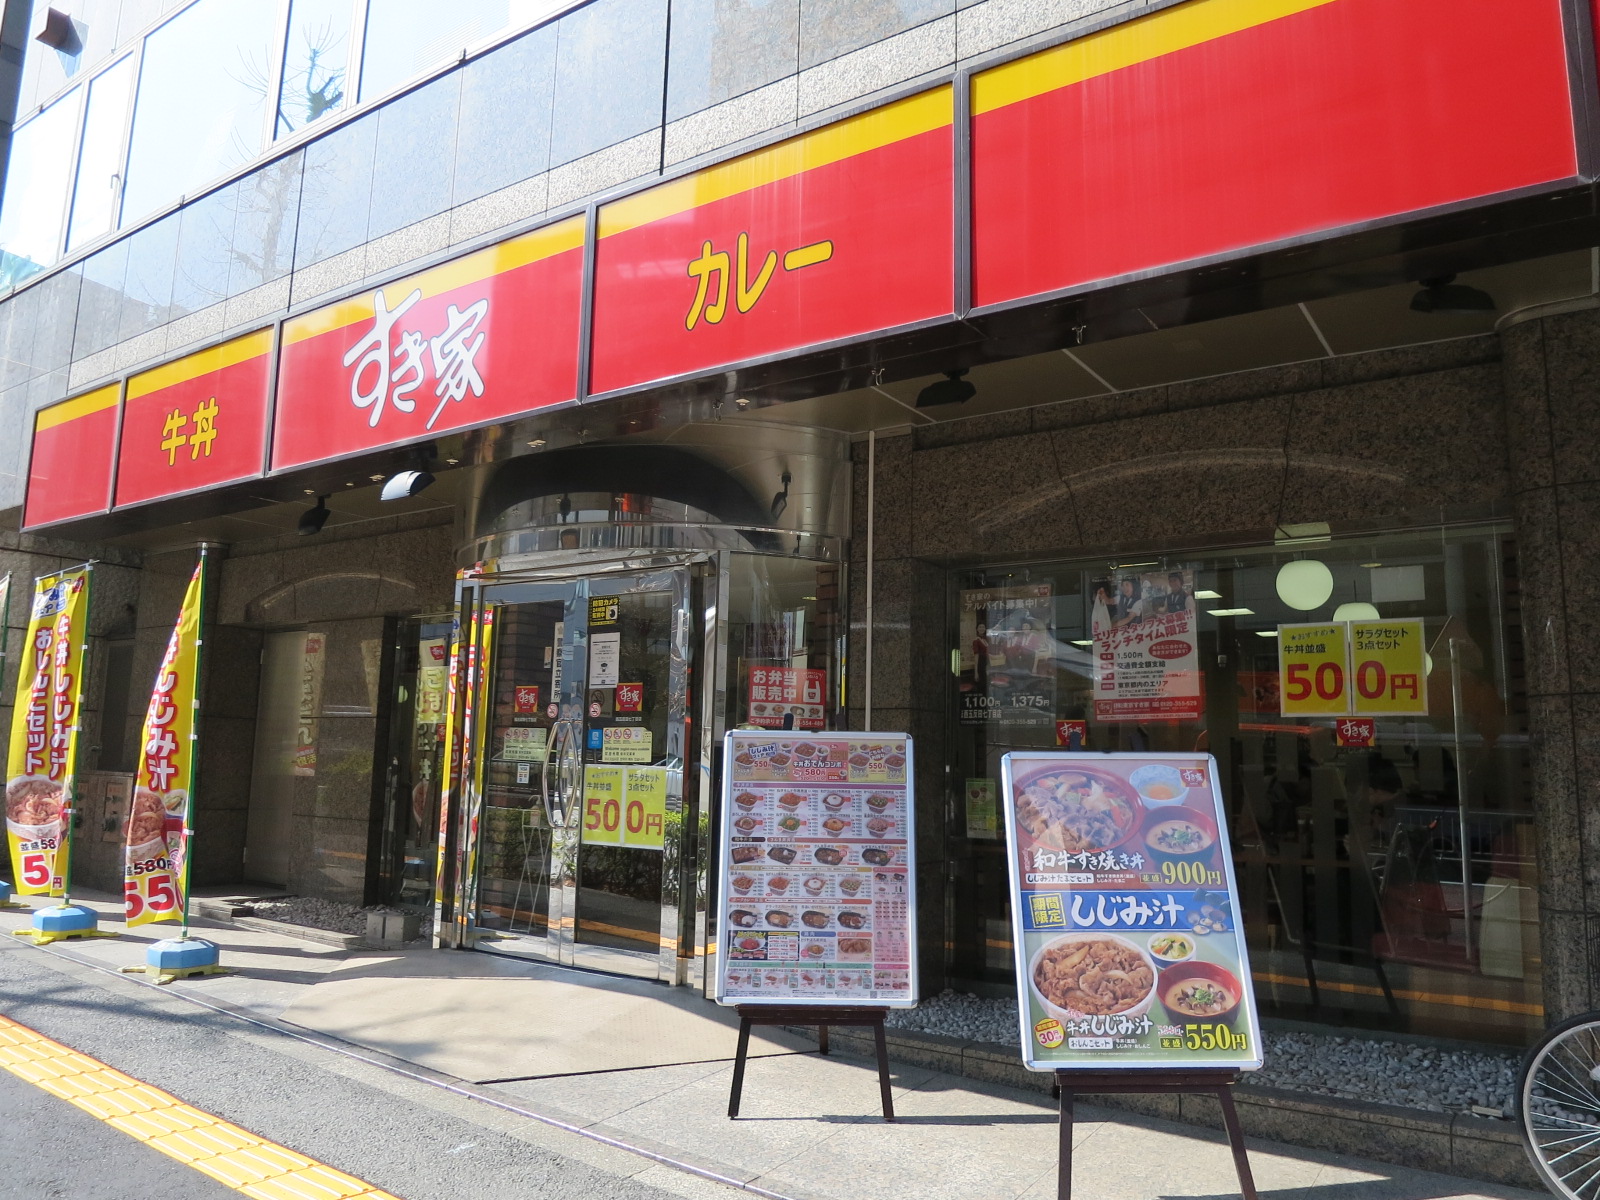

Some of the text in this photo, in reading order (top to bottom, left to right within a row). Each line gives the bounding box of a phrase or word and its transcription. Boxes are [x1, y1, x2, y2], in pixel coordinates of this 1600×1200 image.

[684, 232, 834, 331] カレー
[343, 288, 489, 430] すき家
[160, 396, 218, 466] 牛丼
[1101, 621, 1190, 653] ランチタイム限定
[1355, 627, 1409, 639] サラダセット
[1284, 643, 1327, 654] 牛丼並盛
[1356, 640, 1401, 650] 3点セット
[753, 670, 797, 686] お弁当
[26, 627, 54, 775] おしんこセット
[517, 686, 536, 704] すき家
[618, 685, 641, 704] すき家
[752, 686, 797, 702] 販売中
[965, 695, 1050, 709] 1,100円 1,375円
[1341, 719, 1370, 739] すき家
[628, 774, 660, 782] サラダセット
[1183, 769, 1203, 783] すき家
[628, 783, 655, 792] 3点セット
[1033, 847, 1146, 872] 和牛すき焼き丼
[1027, 874, 1092, 884] しじみ汁たまごセット
[1162, 861, 1222, 886] 900円
[1031, 895, 1060, 911] 期間
[1070, 893, 1185, 927] しじみ汁
[1034, 909, 1064, 925] 限定
[1066, 1015, 1154, 1037] 牛丼しじみ汁
[1069, 1039, 1113, 1048] おしんこセット
[1185, 1023, 1247, 1050] 550円
